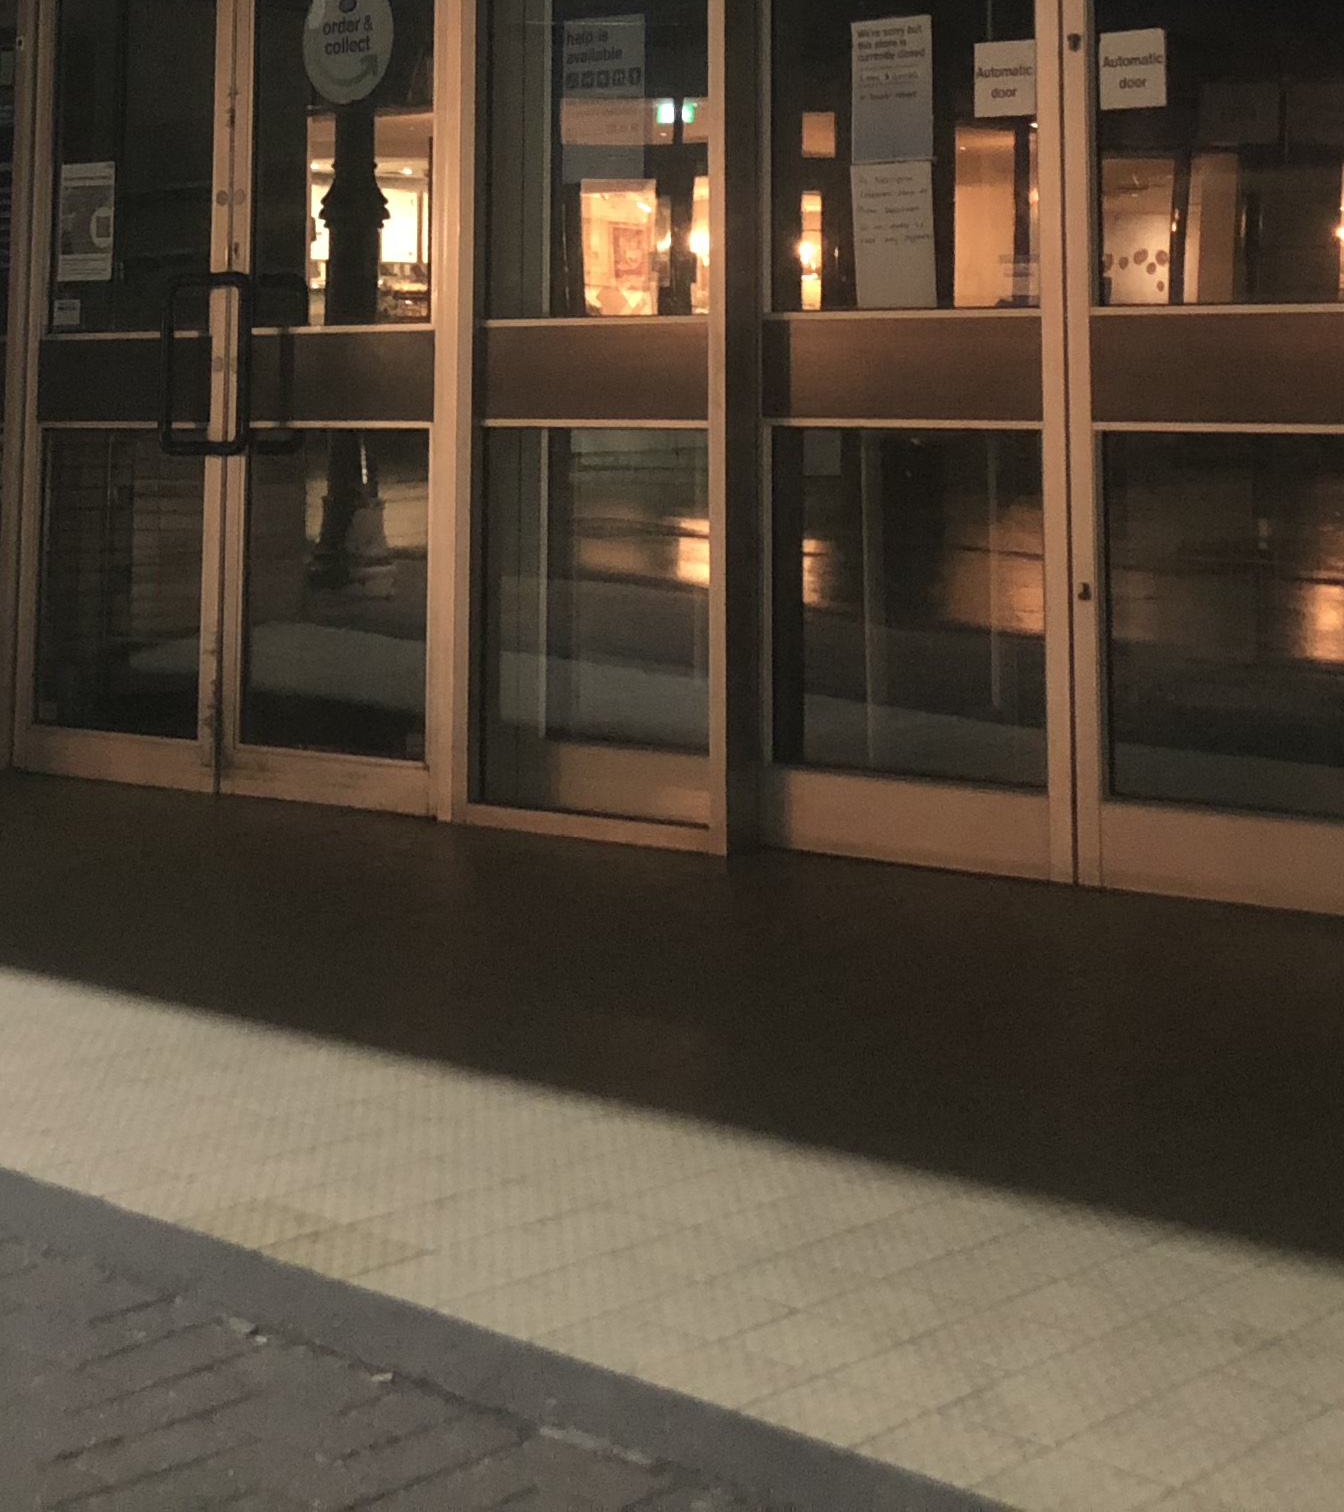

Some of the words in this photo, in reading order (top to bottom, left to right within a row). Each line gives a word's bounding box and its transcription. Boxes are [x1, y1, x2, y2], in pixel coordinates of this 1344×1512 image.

[322, 15, 361, 36] order
[363, 14, 374, 32] &
[324, 35, 372, 56] collect
[566, 30, 594, 47] help
[597, 29, 609, 43] is
[566, 46, 623, 65] available
[1102, 52, 1164, 70] Automatic
[976, 64, 1034, 80] Automatic
[1118, 76, 1148, 90] door
[990, 87, 1018, 100] door
